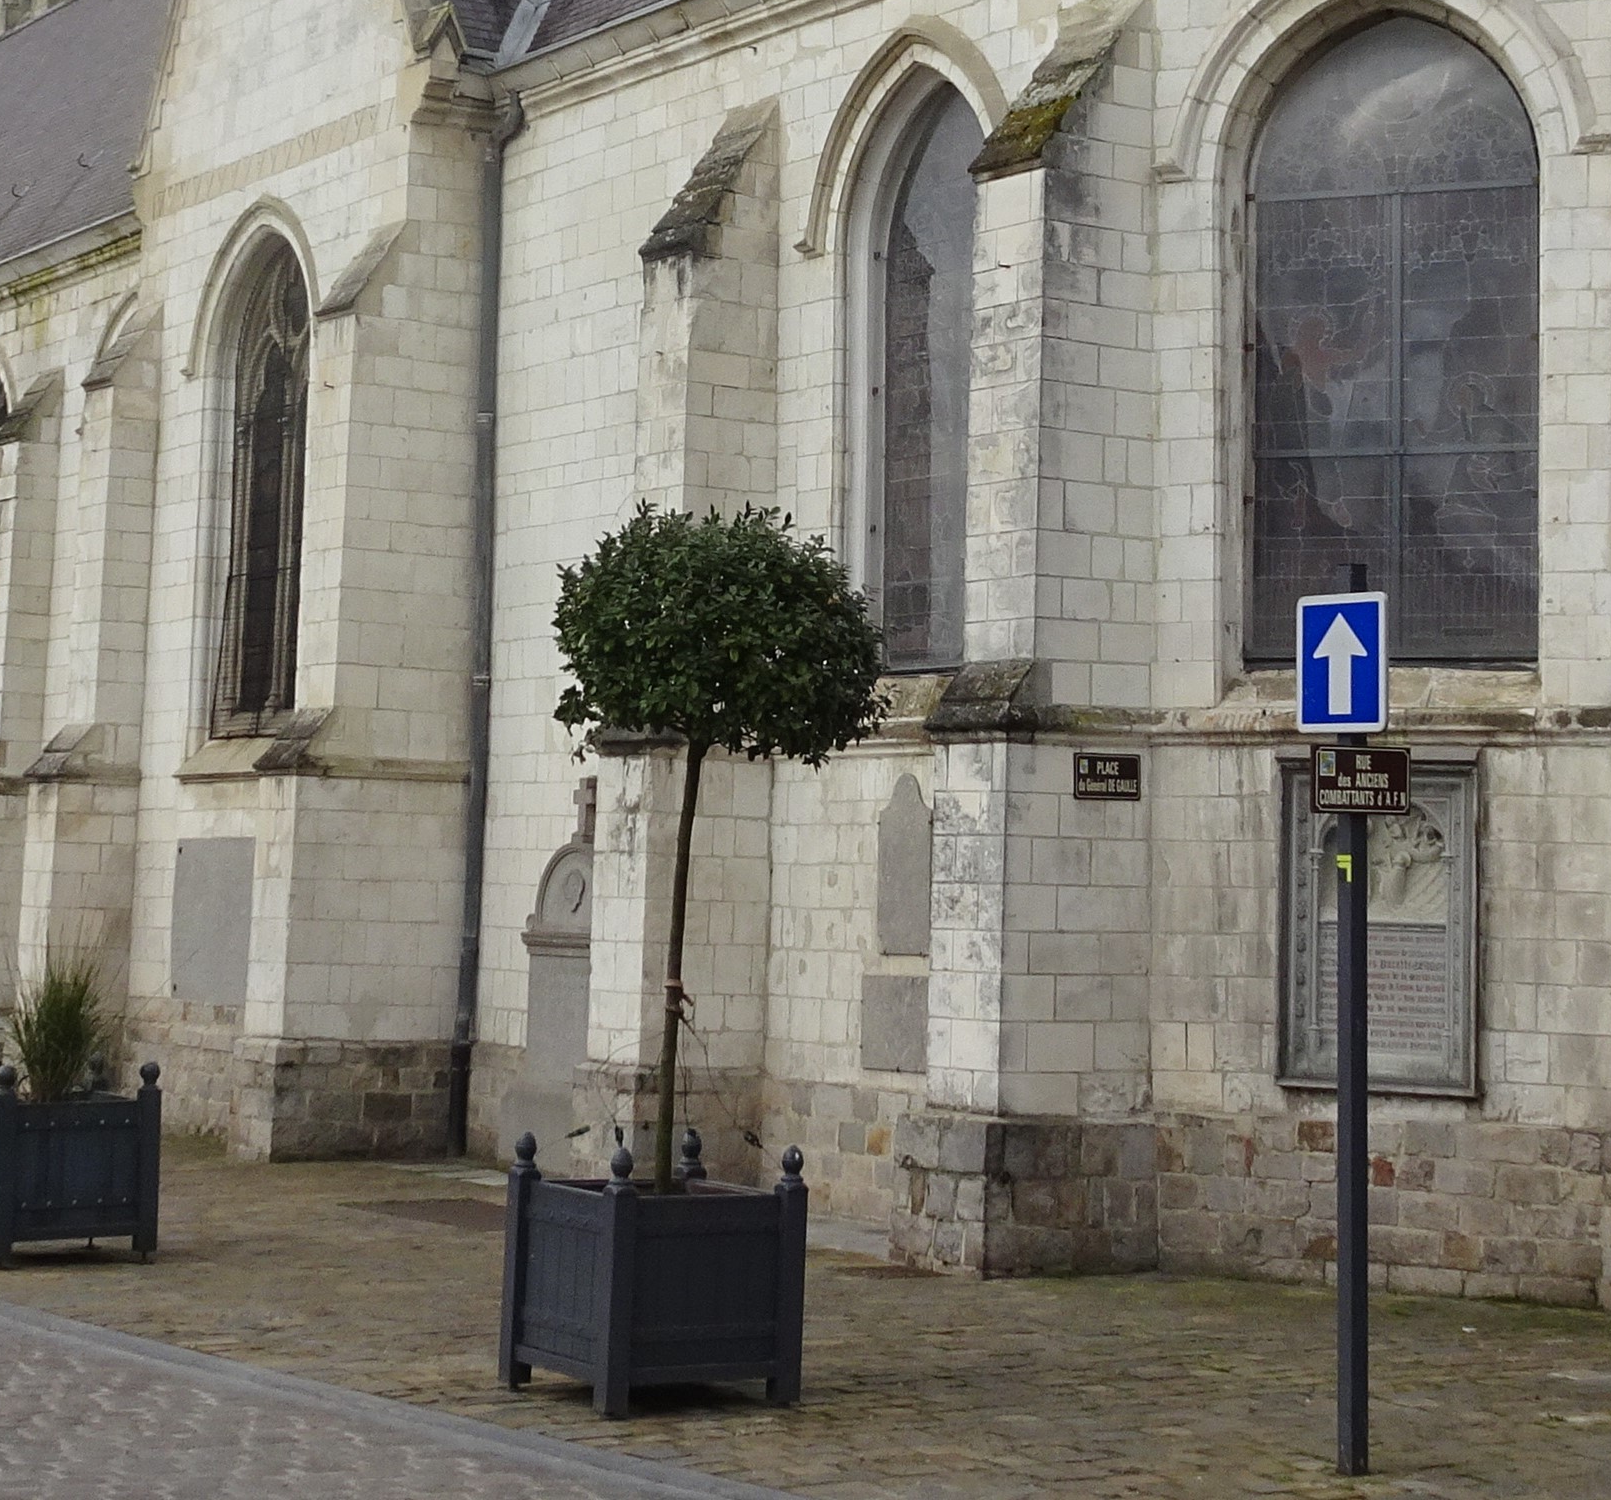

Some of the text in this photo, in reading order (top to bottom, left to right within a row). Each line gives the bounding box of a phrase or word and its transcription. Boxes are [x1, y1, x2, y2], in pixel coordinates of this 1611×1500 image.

[1096, 761, 1119, 775] PLACE
[1355, 754, 1371, 770] RUE
[1078, 778, 1086, 792] du
[1108, 779, 1116, 792] DE
[1116, 779, 1137, 792] GAULLE
[1338, 772, 1389, 788] des ANCIENS
[1319, 789, 1374, 806] COMBATTANTS
